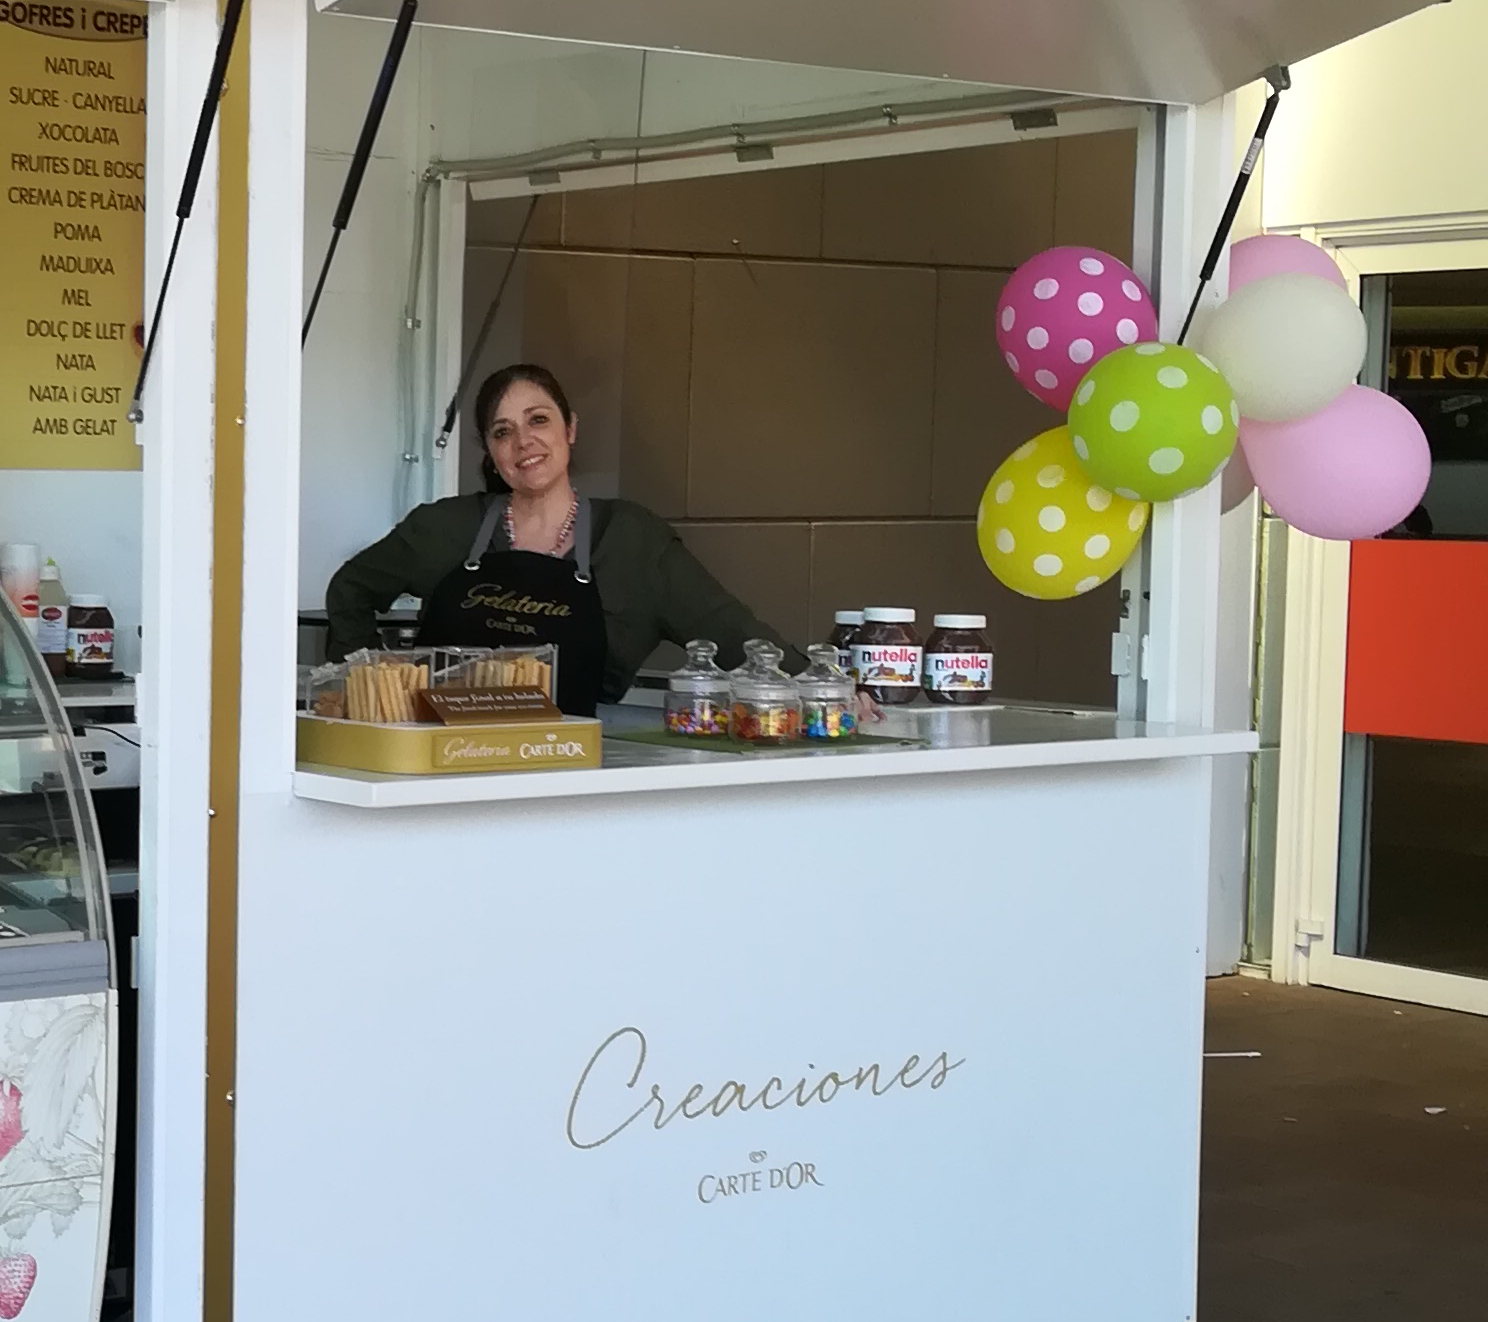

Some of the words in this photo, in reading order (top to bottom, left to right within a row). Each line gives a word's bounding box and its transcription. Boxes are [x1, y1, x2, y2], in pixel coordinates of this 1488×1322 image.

[44, 55, 115, 80] NATURAL
[9, 86, 60, 108] SUCRE
[72, 91, 148, 115] CANYELLA
[37, 121, 120, 146] XOCOLATA
[11, 153, 70, 175] FRUITES
[73, 158, 100, 178] DEL
[103, 160, 145, 180] BOSC
[8, 186, 64, 207] CREMA
[67, 189, 87, 209] DE
[90, 188, 147, 213] PLÀTAN
[53, 221, 103, 242] POMA
[39, 254, 115, 275] MADUIXA
[61, 288, 92, 307] MEL
[26, 319, 69, 342] DOLÇ
[72, 322, 93, 339] DE
[95, 322, 126, 340] LLET
[56, 353, 97, 371] NATA
[29, 384, 69, 403] NATA
[81, 386, 122, 404] GUST
[32, 417, 69, 435] AMB
[73, 418, 118, 436] GELAT
[460, 583, 573, 617] Gelateria
[862, 649, 918, 663] nutella
[935, 656, 988, 670] nutella
[519, 742, 555, 759] CARTE
[566, 1026, 967, 1150] Creaciones
[697, 1170, 762, 1204] CARTE
[769, 1161, 825, 1190] D'OR
